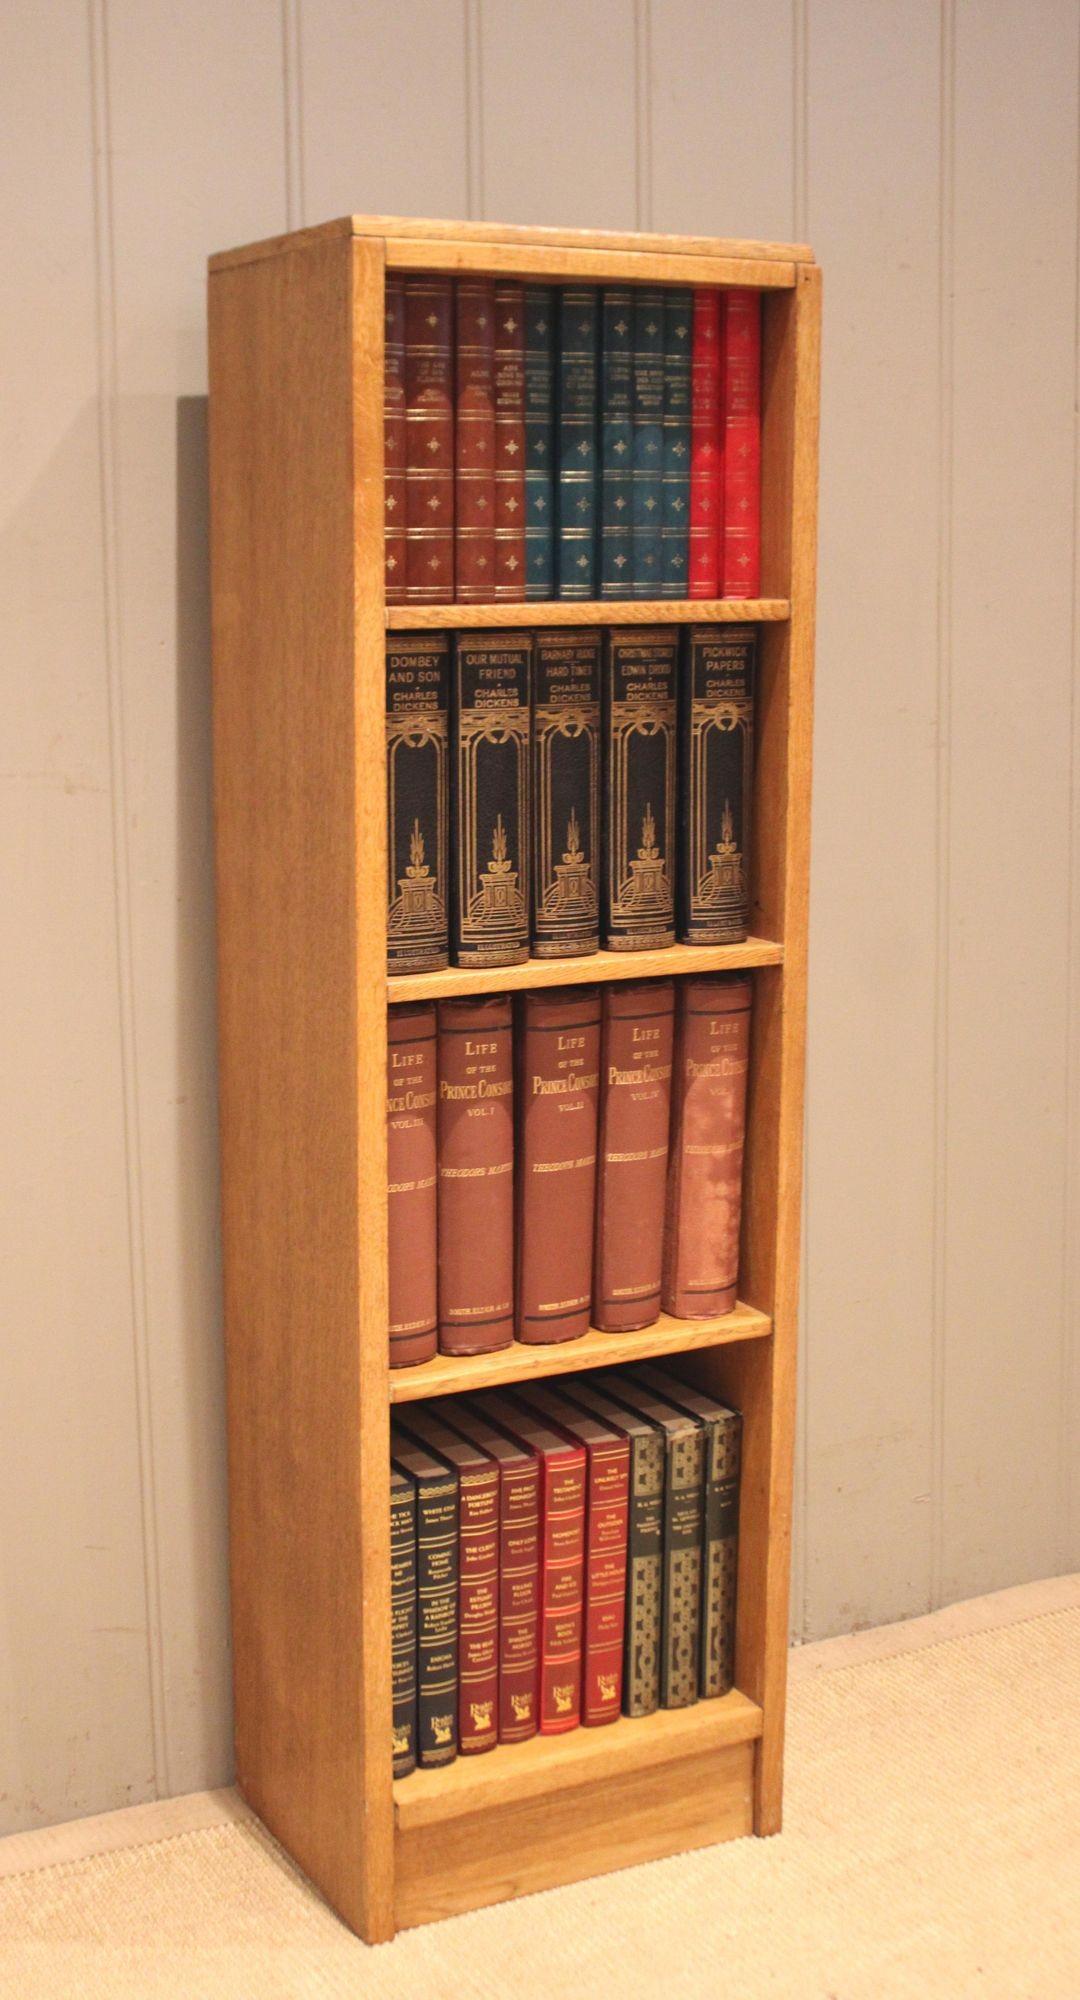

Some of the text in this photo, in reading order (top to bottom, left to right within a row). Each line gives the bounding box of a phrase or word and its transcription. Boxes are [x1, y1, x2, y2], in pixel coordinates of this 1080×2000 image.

[702, 647, 748, 657] PICKWICK
[390, 656, 440, 668] DOMBEY
[466, 653, 523, 665] OUR MUTUAL
[621, 665, 647, 676] EDWIN
[706, 661, 745, 671] PAPERS
[479, 668, 516, 680] FRIEND
[546, 666, 569, 677] HARD
[389, 671, 440, 683] AND SON
[549, 683, 591, 693] CHARLES
[626, 682, 668, 691] CHARLES
[706, 680, 745, 688] CHARLES
[393, 691, 438, 701] CHARLES
[474, 688, 519, 698] CHARLES
[549, 693, 592, 703] DICKENS
[626, 692, 668, 701] DICKENS
[706, 689, 746, 698] DICKENS
[393, 701, 439, 712] DICKENS
[474, 698, 519, 708] DICKENS
[645, 1050, 659, 1058] THE
[558, 1058, 584, 1069] OF THE
[479, 1065, 496, 1073] THE
[408, 1076, 423, 1084] THE
[468, 1498, 494, 1508] FORTUNE
[422, 1508, 442, 1516] WHITE
[478, 1542, 496, 1552] CLIENT
[508, 1539, 524, 1547] ONLY
[428, 1551, 452, 1560] COMING
[431, 1559, 449, 1567] HOME
[512, 1582, 533, 1591] KILLING
[557, 1630, 572, 1638] BOOK
[430, 1654, 452, 1663] ENIGMA
